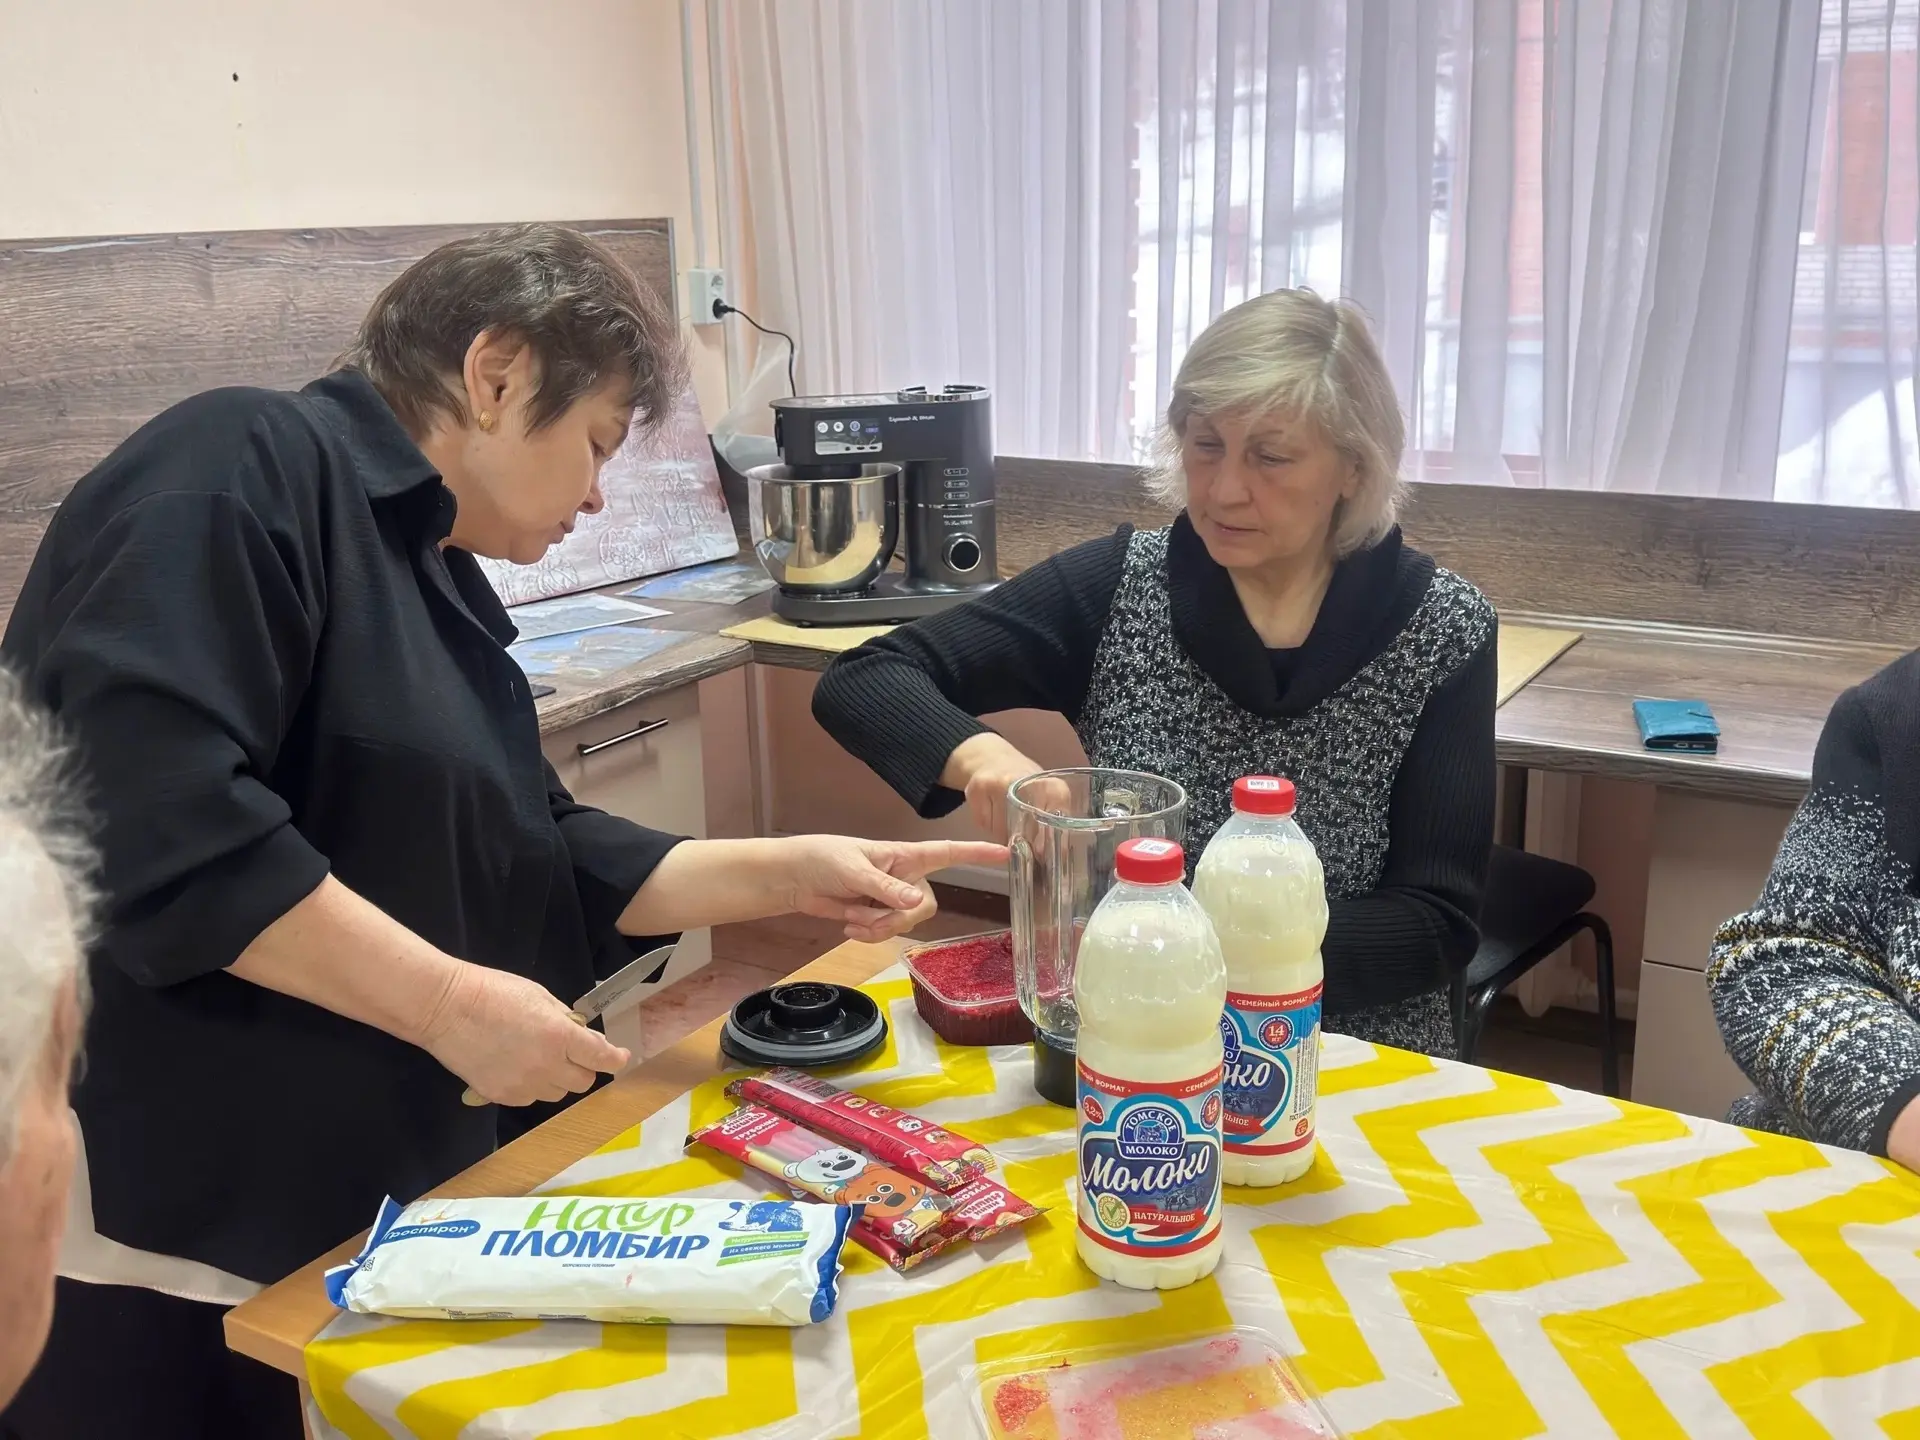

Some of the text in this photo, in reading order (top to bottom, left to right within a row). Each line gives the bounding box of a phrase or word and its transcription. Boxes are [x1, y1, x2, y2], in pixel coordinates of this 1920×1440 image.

[1236, 996, 1308, 1007] СЕМЕЙНЫЙ ФОРМАТ
[1095, 1079, 1126, 1093] ФОРМАТ
[1125, 1110, 1177, 1131] ТОМСКОЕ
[1125, 1145, 1178, 1156] МОЛОКО
[1084, 1145, 1210, 1193] Молоко
[523, 1198, 695, 1235] Натур
[1134, 1211, 1195, 1223] НАТУРАЛЬНОЕ
[480, 1230, 710, 1259] ПЛОМБИР
